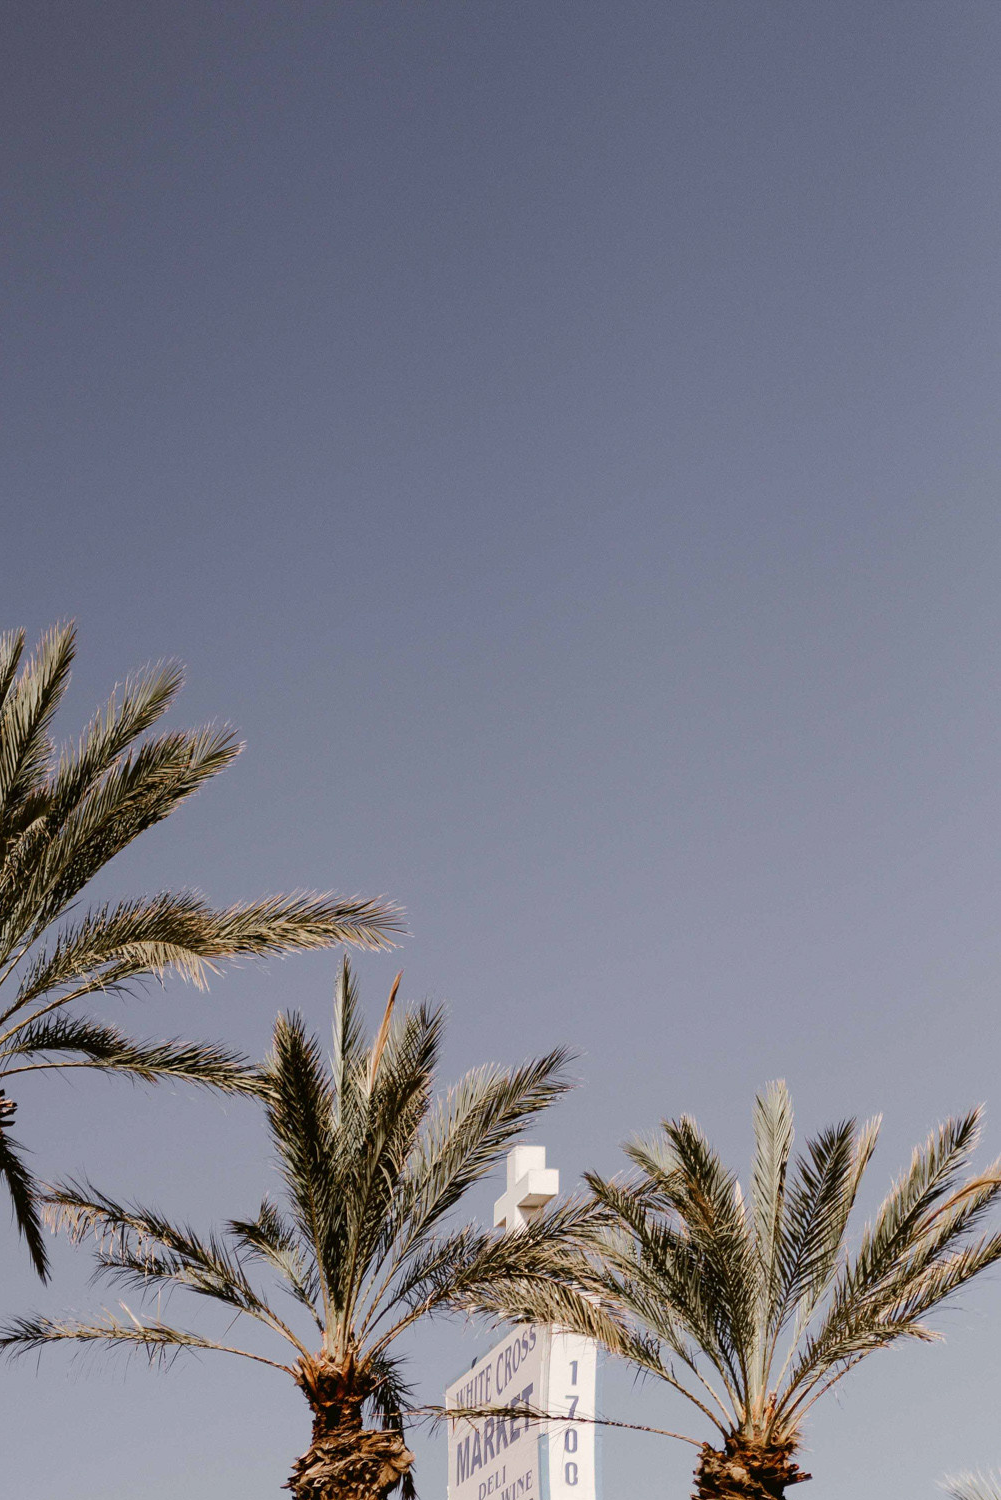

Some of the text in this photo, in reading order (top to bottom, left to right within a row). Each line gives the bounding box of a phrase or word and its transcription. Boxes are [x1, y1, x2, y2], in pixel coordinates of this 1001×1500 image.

[456, 1324, 537, 1411] WHITE CROSS
[456, 1382, 535, 1487] MARKET
